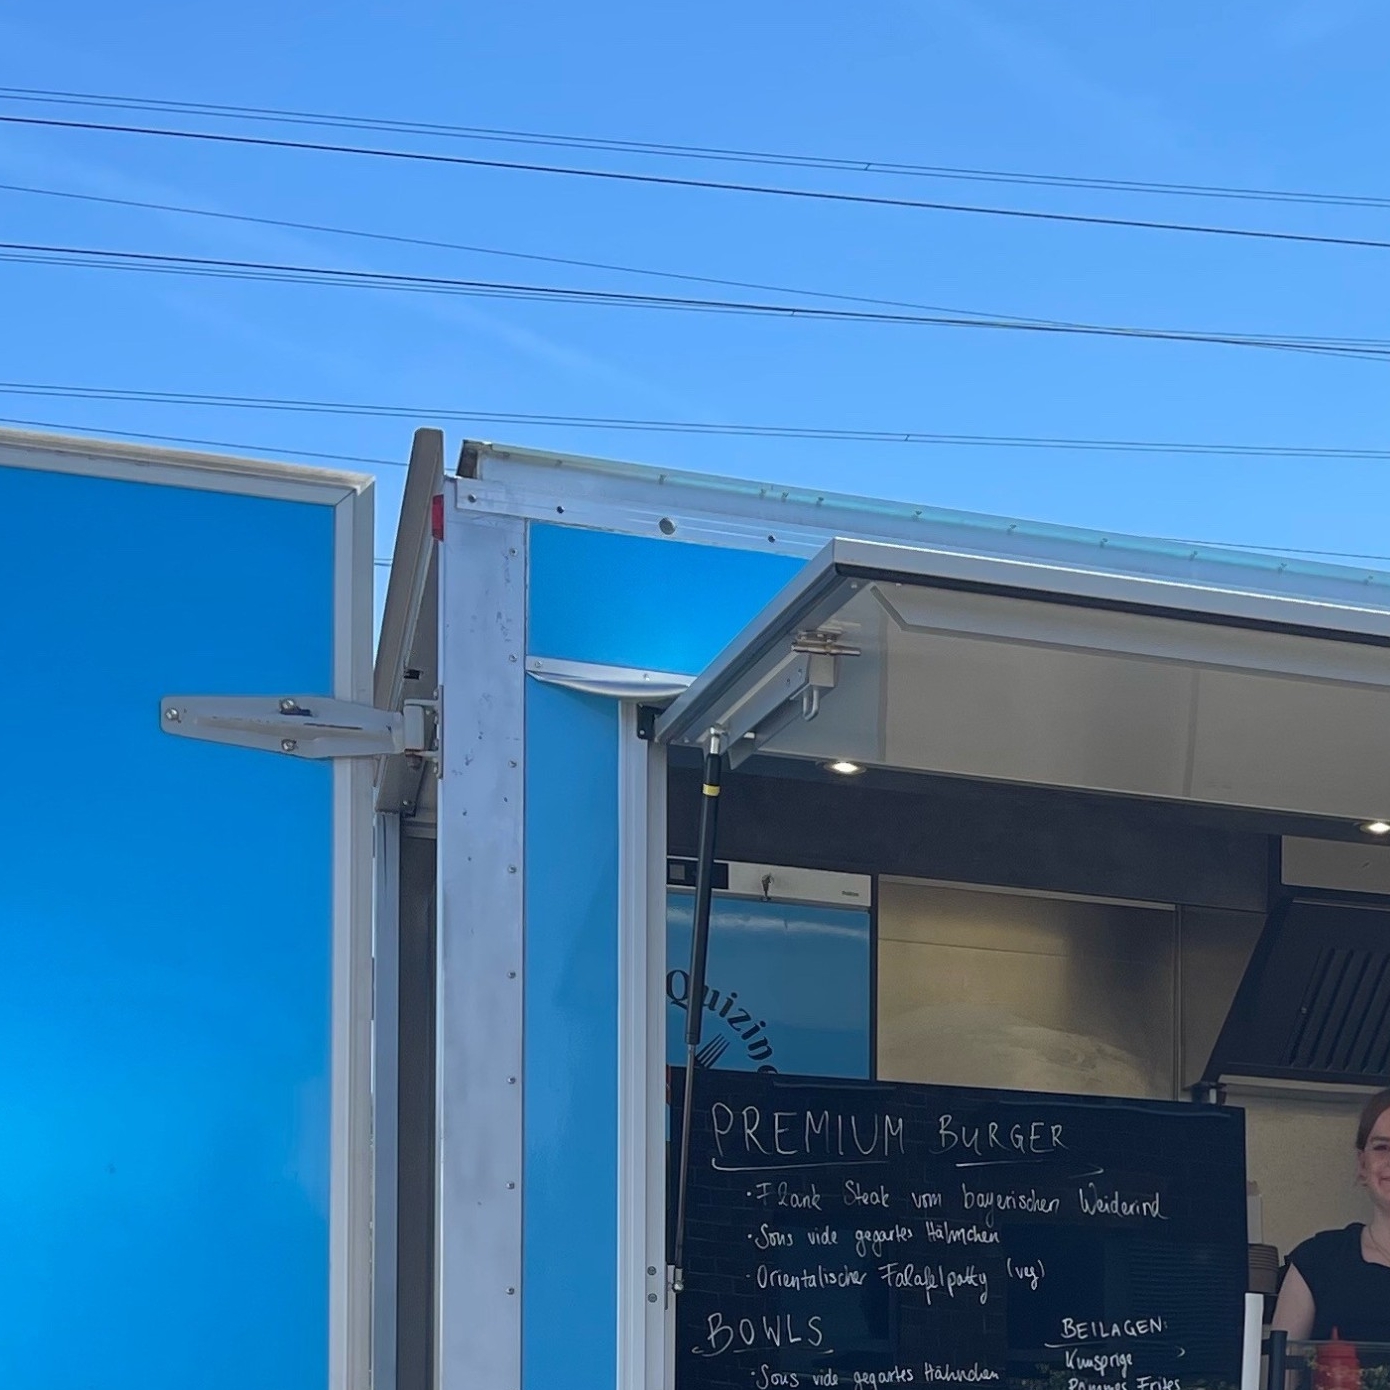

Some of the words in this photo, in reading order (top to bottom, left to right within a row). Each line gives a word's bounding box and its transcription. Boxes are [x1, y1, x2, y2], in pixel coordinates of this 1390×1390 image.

[711, 1102, 905, 1157] PREMIUM
[929, 1114, 1069, 1155] BURGER
[844, 1179, 890, 1208] Steak
[911, 1191, 943, 1209] vom
[961, 1183, 1060, 1229] bayerischen
[1079, 1182, 1169, 1220] Weiderind
[807, 1225, 839, 1245] vide
[855, 1224, 914, 1258] gegartes
[756, 1264, 867, 1291] Orientalischer
[877, 1262, 989, 1306] Falafelpatty
[1006, 1257, 1046, 1291] (veg)
[707, 1312, 824, 1351] BOWLS
[755, 1364, 800, 1390] Sous
[812, 1368, 839, 1386] vide
